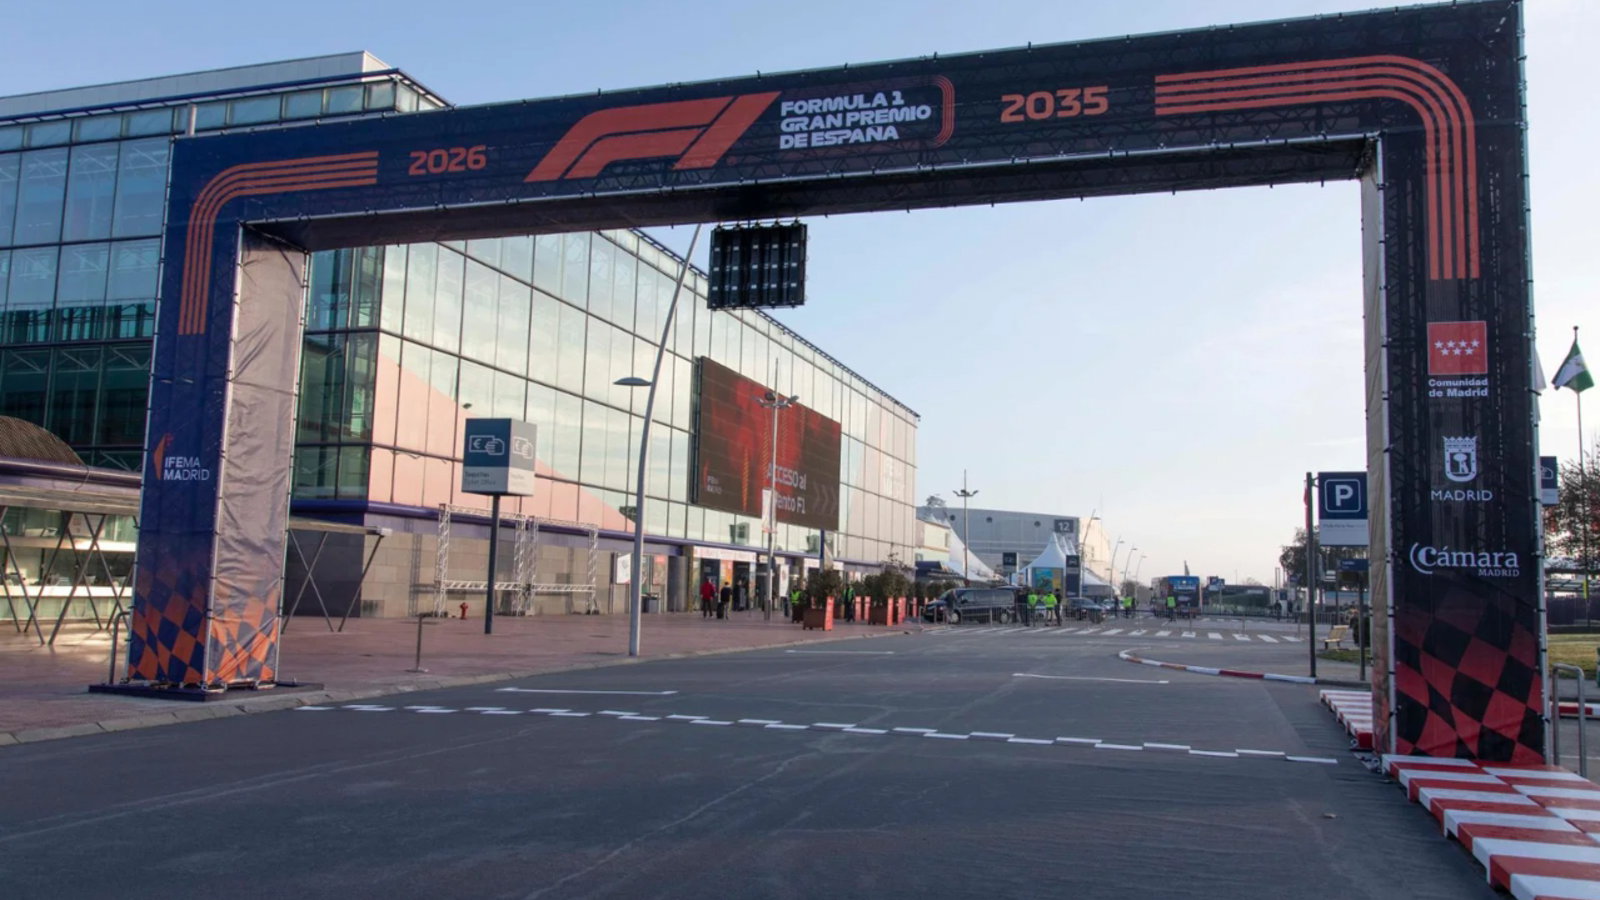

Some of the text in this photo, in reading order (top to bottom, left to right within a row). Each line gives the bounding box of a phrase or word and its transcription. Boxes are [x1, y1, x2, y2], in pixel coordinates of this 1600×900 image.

[781, 90, 904, 116] FORMULA 1
[1000, 85, 1110, 123] 2035
[780, 104, 932, 132] GRAN PREMIO
[779, 132, 808, 150] DE
[408, 145, 487, 176] 2026
[1428, 378, 1489, 387] Comunidad
[1428, 387, 1489, 397] de Madrid
[164, 456, 200, 469] IFEMA
[163, 469, 210, 481] MADRID
[1335, 484, 1354, 507] P
[1431, 490, 1493, 501] MADRID
[1058, 521, 1070, 531] 12
[1418, 545, 1520, 568] Cámara
[1478, 569, 1520, 577] MADRID
